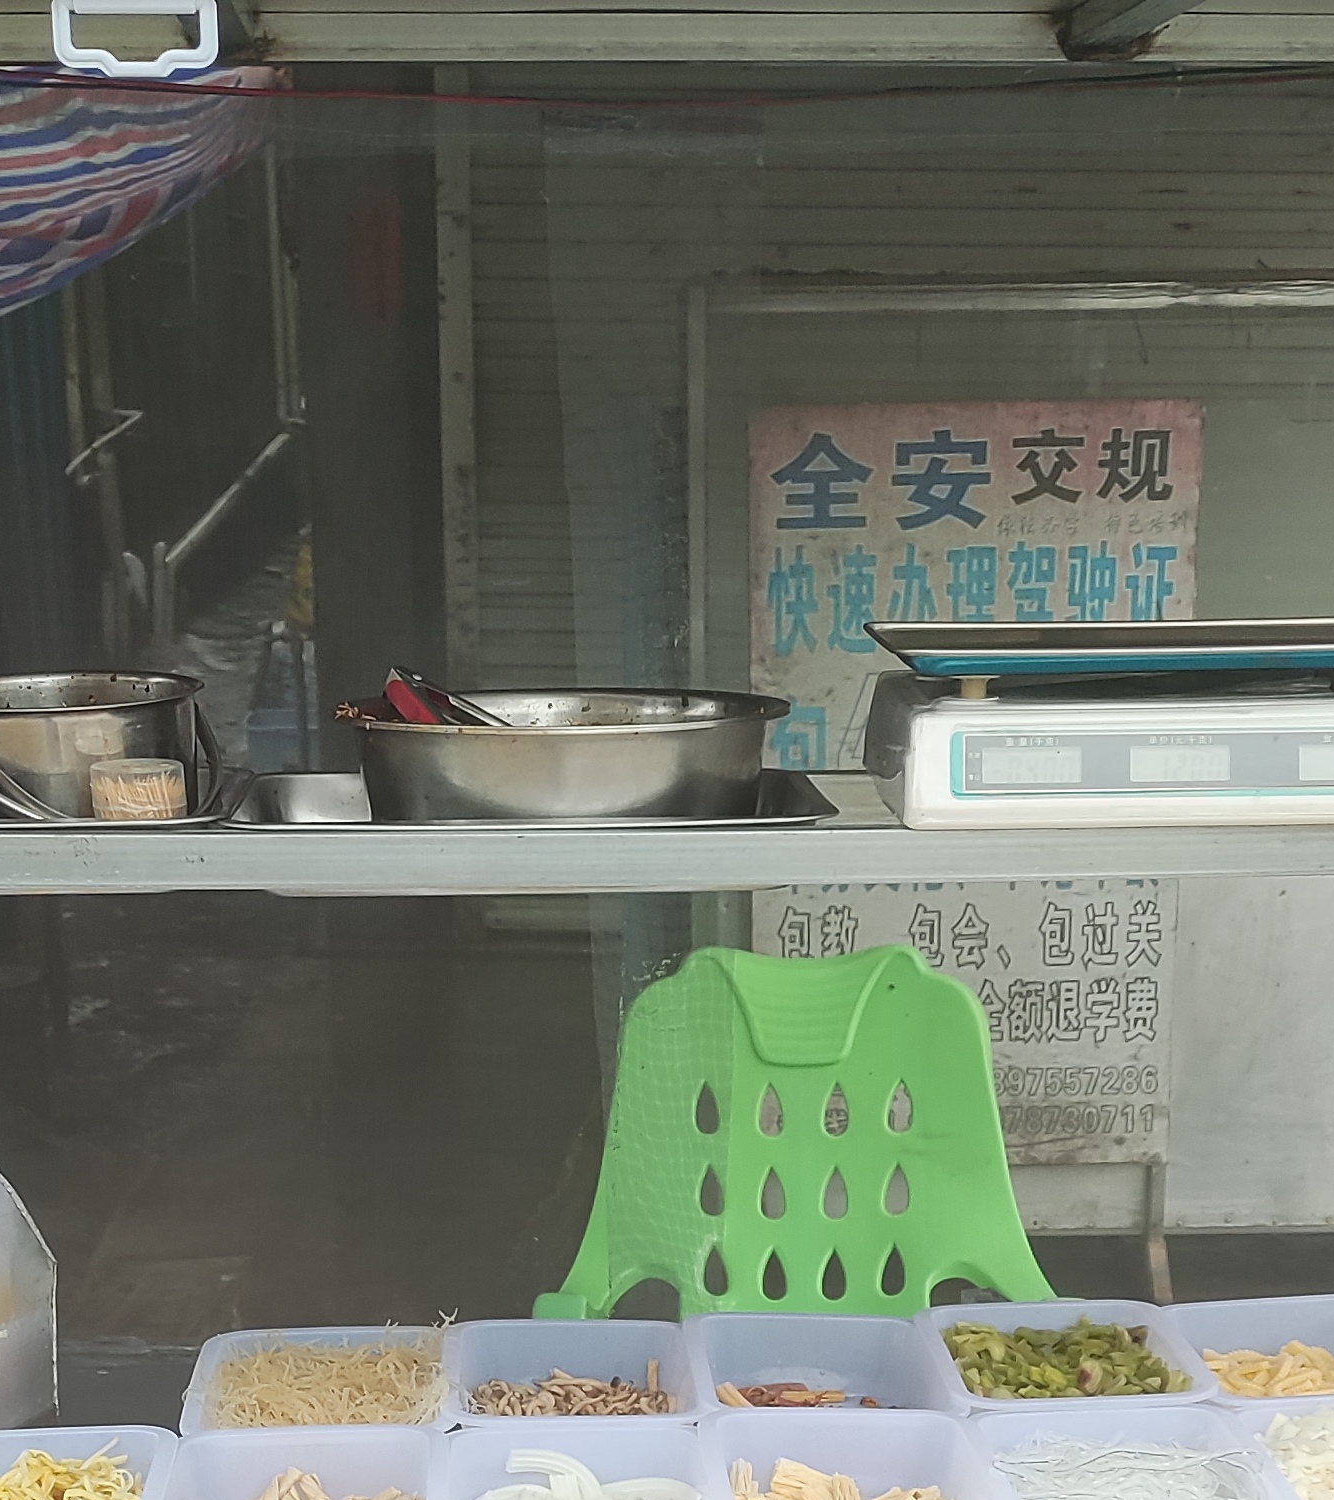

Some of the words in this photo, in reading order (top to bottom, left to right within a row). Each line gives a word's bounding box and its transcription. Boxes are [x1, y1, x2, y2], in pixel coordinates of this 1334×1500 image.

[769, 429, 1174, 531] 全安交规
[768, 540, 1178, 656] 快速办理驾驶证
[778, 900, 1162, 971] 包教包会、包过关
[977, 976, 1159, 1044] 全额退学费
[999, 1103, 1155, 1136] 78730711
